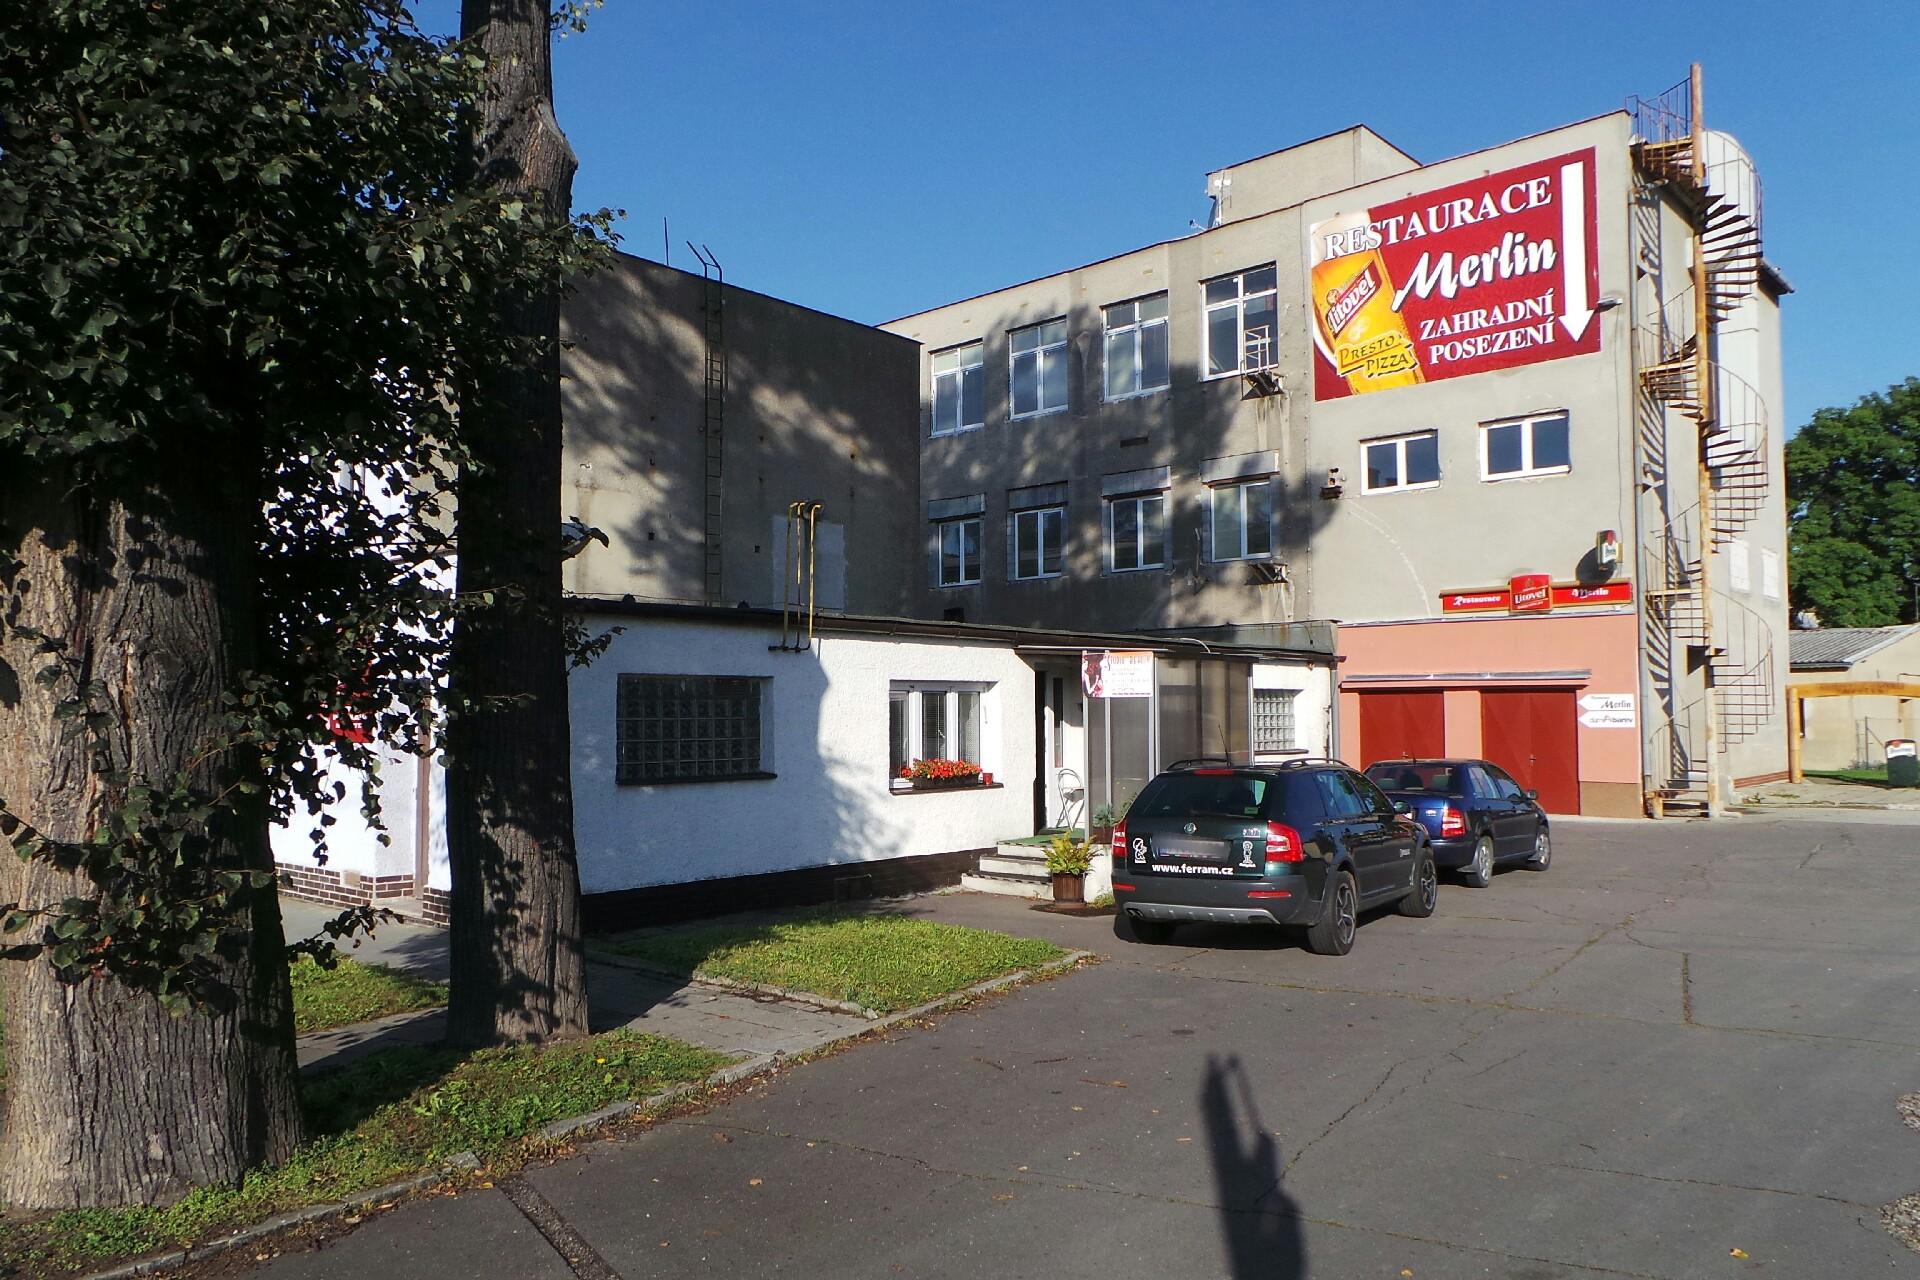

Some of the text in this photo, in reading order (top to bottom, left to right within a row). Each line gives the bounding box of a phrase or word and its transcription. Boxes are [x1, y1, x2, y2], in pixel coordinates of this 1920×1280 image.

[1324, 175, 1552, 261] RESTAURACE
[1391, 231, 1557, 313] Merlin
[1327, 268, 1376, 335] Litovel
[1420, 288, 1555, 342] ZAHRADNÍ
[1339, 335, 1396, 369] PRESTO
[1366, 353, 1409, 371] PIZZA
[1429, 316, 1556, 366] POSEZENÍ
[1151, 862, 1234, 876] www.ferram.cz
